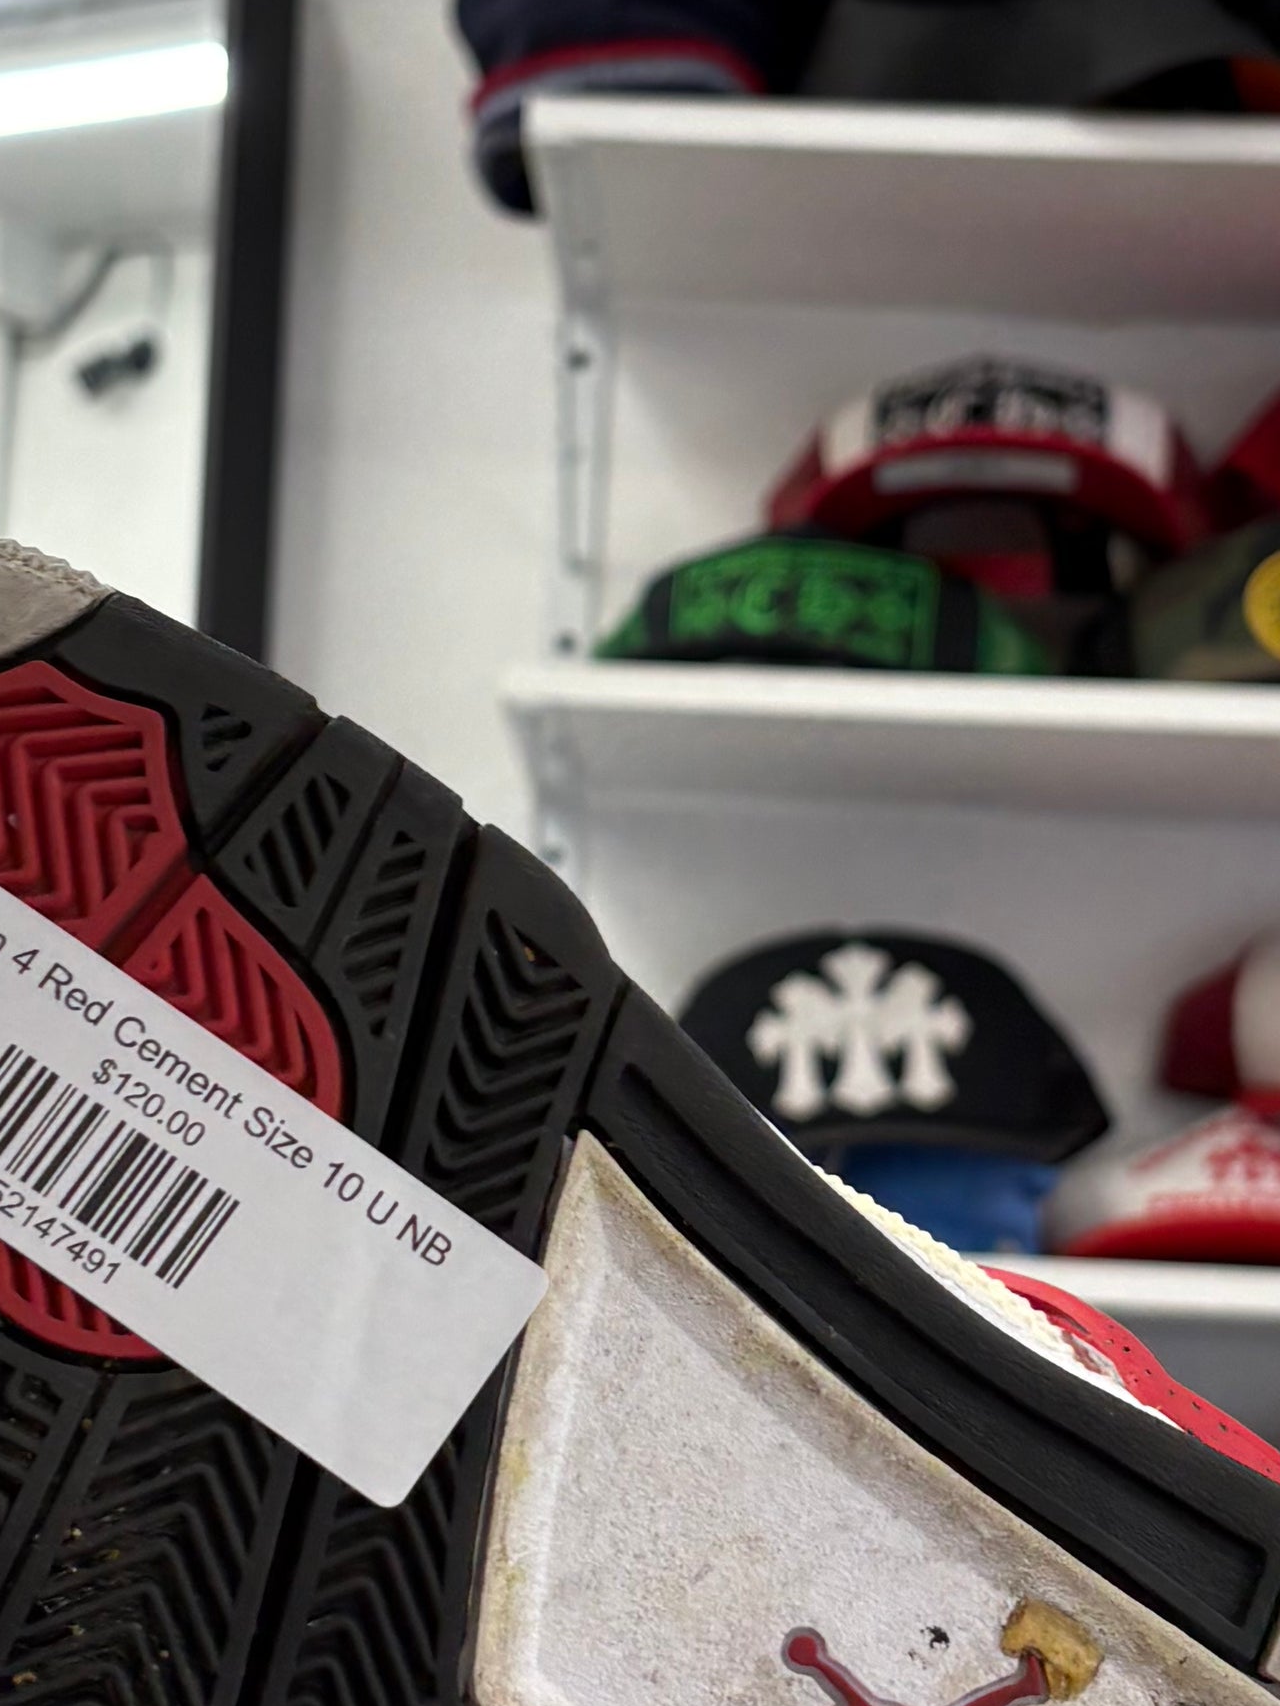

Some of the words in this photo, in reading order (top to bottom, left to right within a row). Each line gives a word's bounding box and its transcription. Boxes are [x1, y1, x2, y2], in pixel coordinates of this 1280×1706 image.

[11, 948, 41, 975] 4
[37, 961, 115, 1027] Red
[113, 1016, 243, 1120] Cement
[243, 1106, 314, 1169] Size
[323, 1162, 365, 1203] 10
[366, 1190, 399, 1226] U
[395, 1213, 452, 1267] NB
[91, 1058, 206, 1147] $120.00
